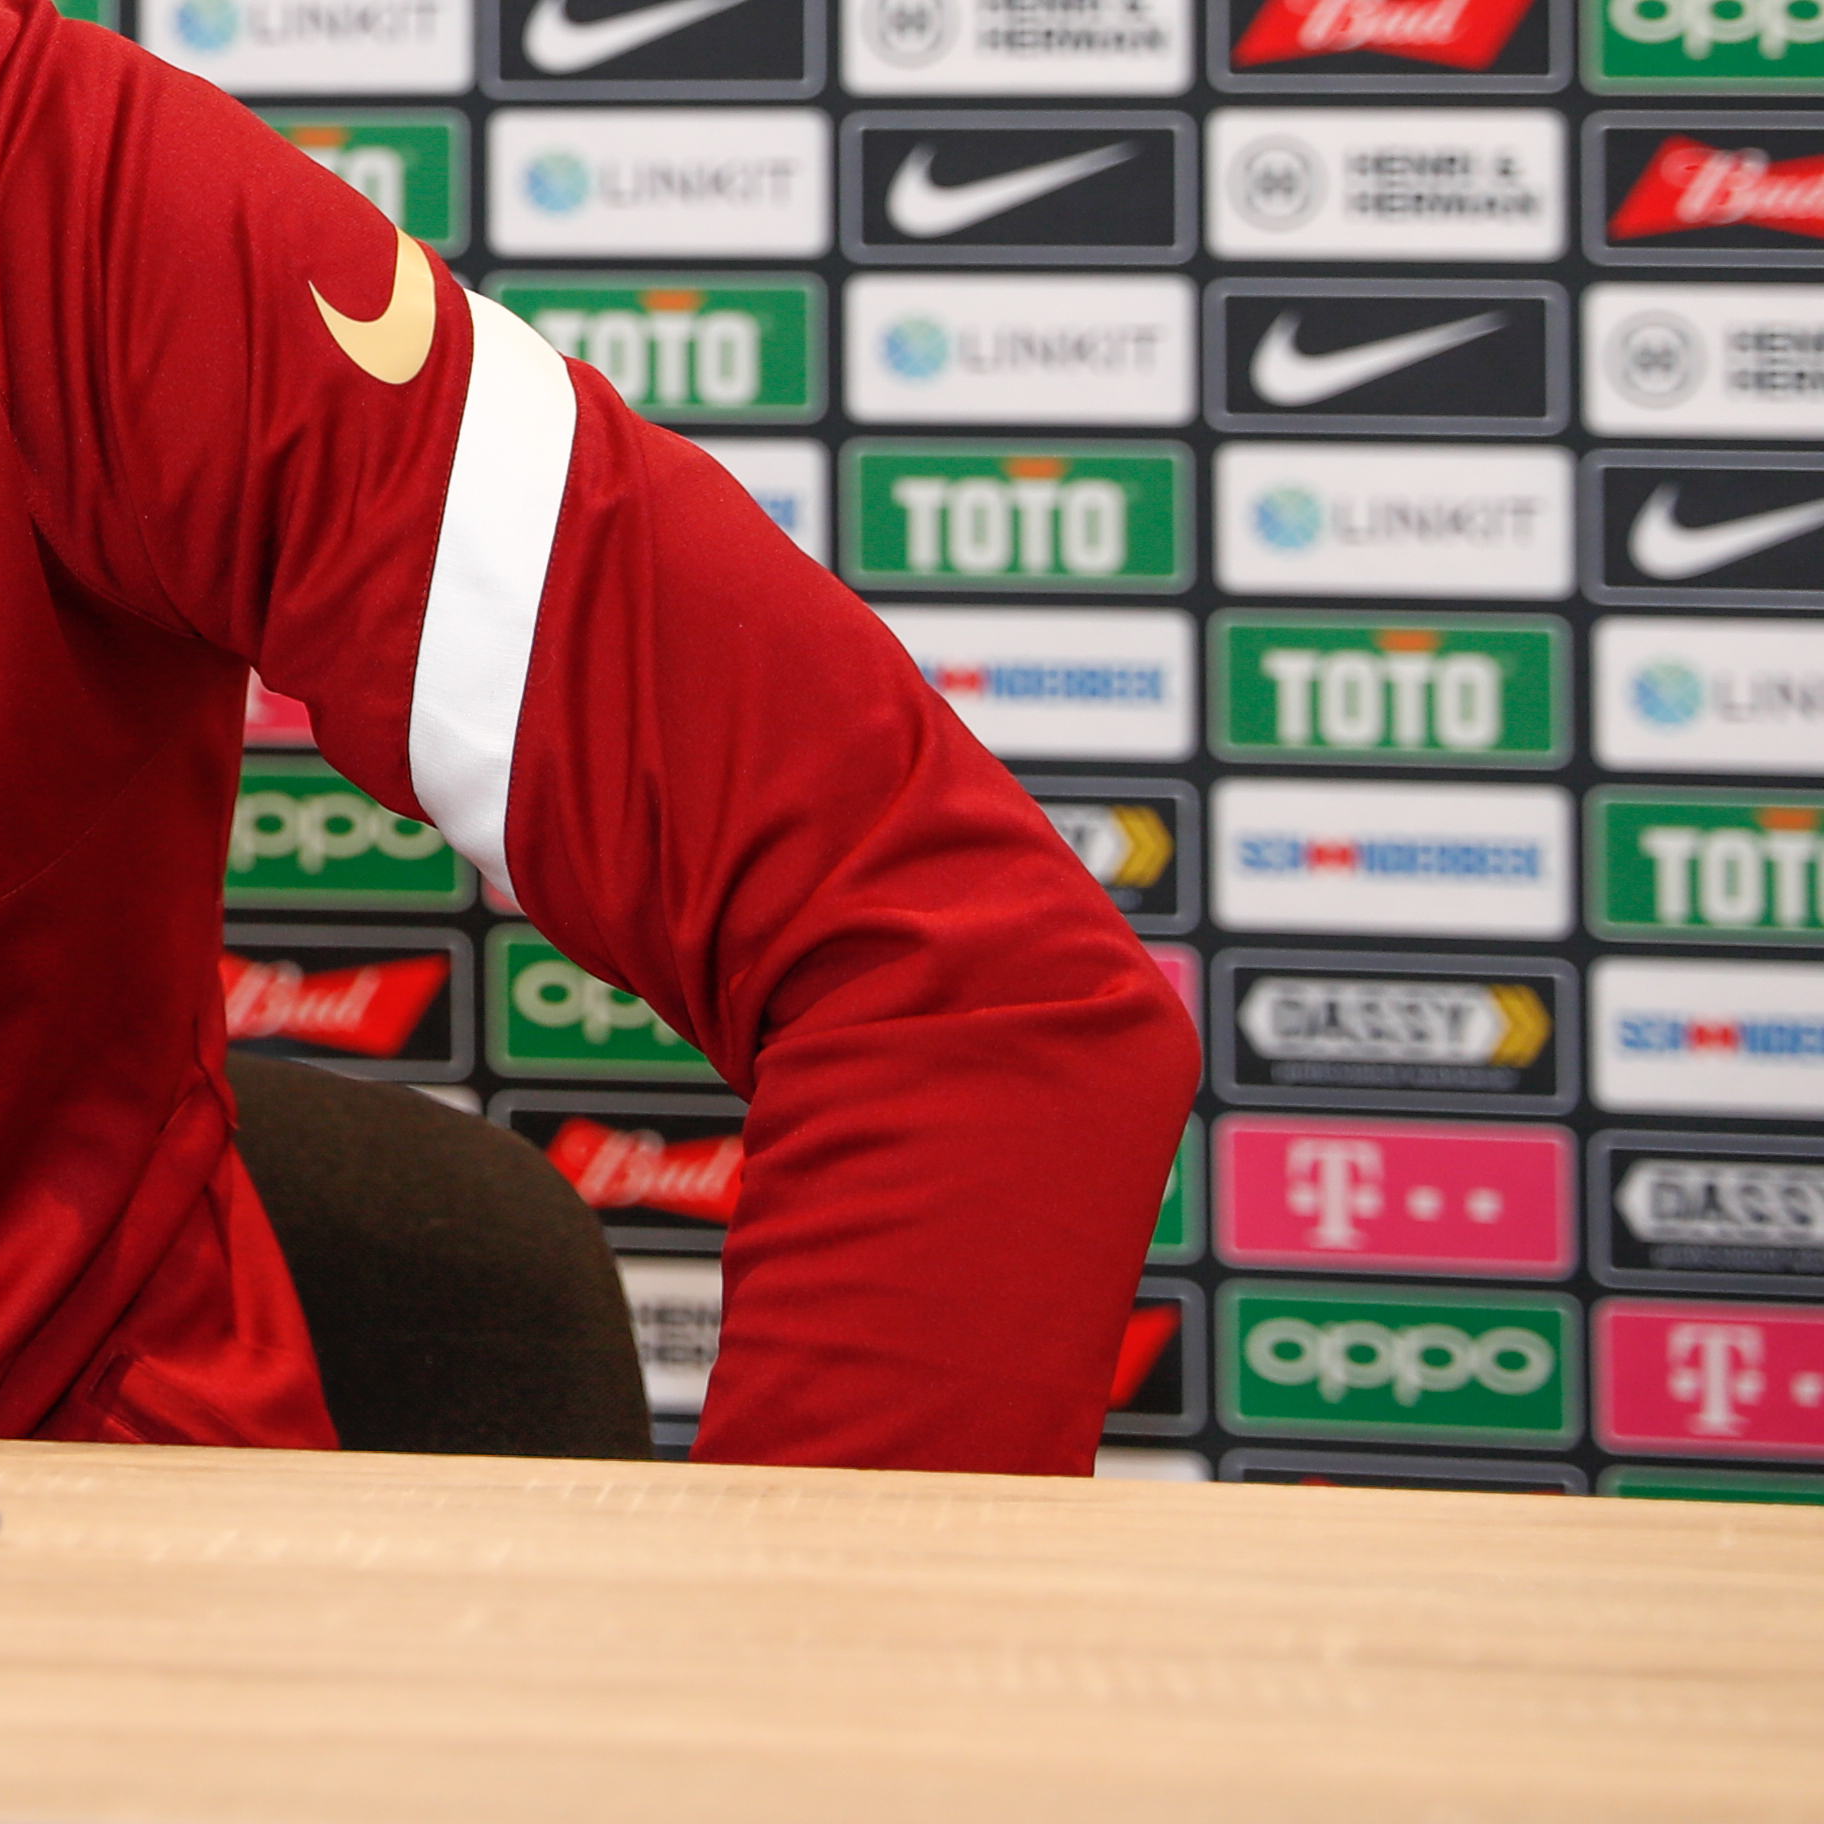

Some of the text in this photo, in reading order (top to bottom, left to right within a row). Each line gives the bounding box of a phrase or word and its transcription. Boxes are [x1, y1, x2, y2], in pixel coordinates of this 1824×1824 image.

[597, 160, 797, 209] LINKIT
[956, 326, 1161, 376] LINKIT
[890, 474, 1126, 576] TOTO
[1330, 497, 1540, 548] LINKIT
[1260, 647, 1502, 751] TOTO
[238, 794, 441, 881] ppo
[1638, 824, 1824, 931] TOT
[1270, 995, 1475, 1044] DASSY
[1648, 1177, 1824, 1227] DASS
[1243, 1316, 1556, 1412] oppo
